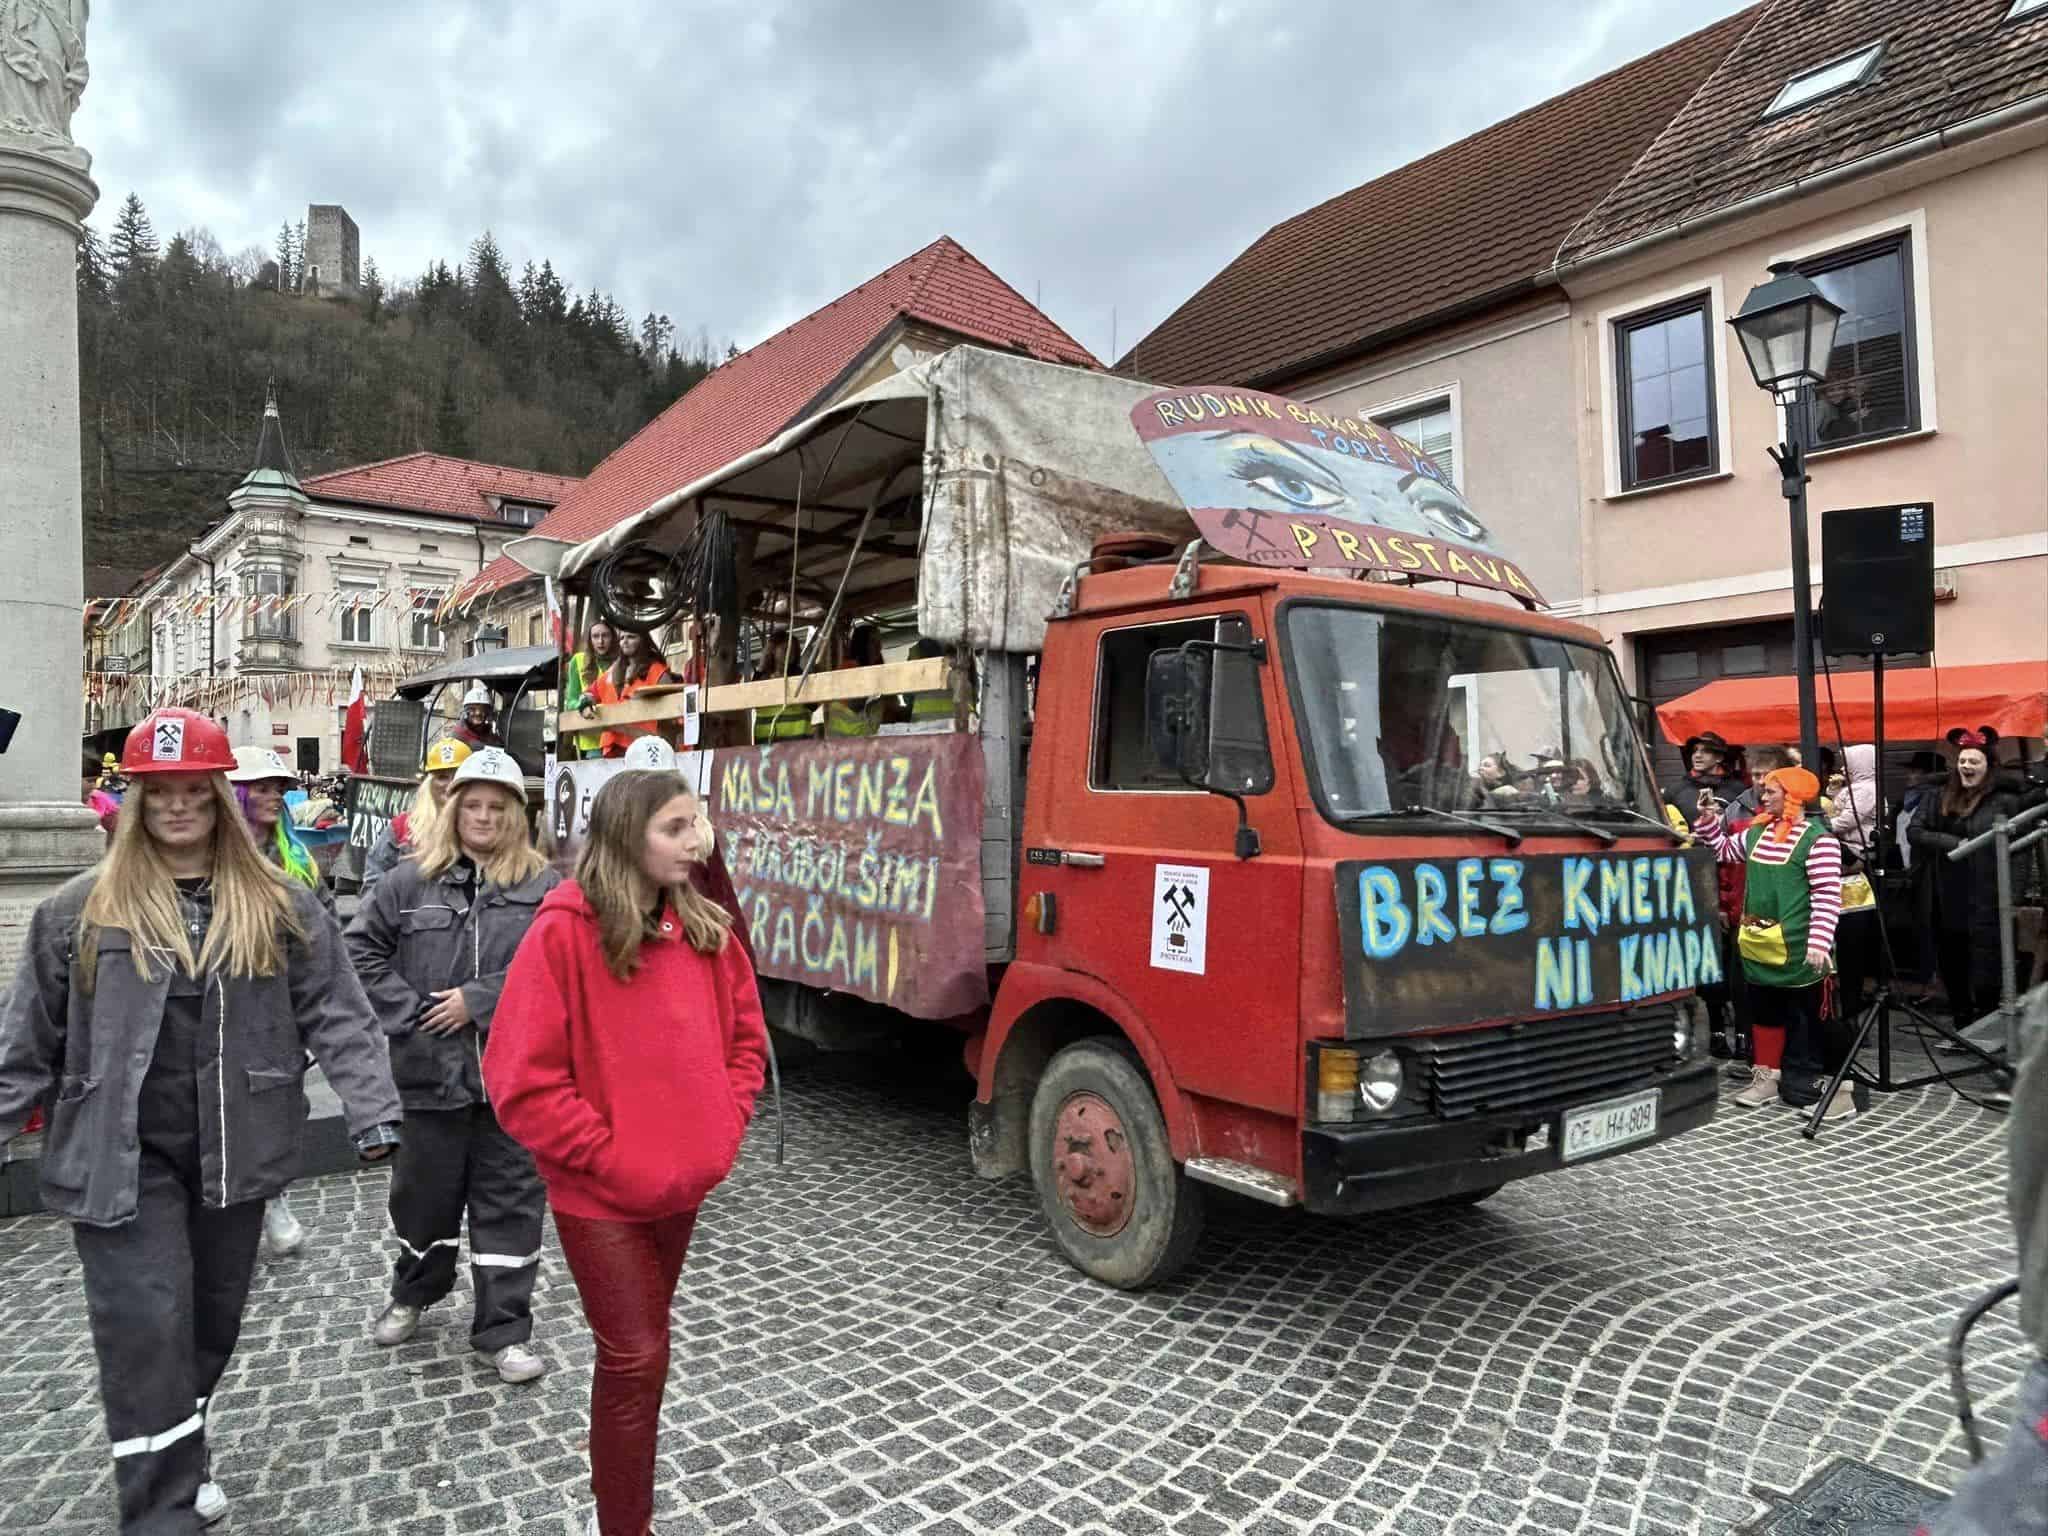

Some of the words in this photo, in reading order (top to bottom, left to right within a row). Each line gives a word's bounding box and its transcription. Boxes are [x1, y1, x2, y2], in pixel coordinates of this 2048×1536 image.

[1154, 393, 1281, 427] RUDNIK
[1286, 403, 1382, 441] BAKRA
[1310, 428, 1397, 464] TOPLE
[1289, 523, 1538, 597] PRISTAVA
[719, 745, 797, 824] NAŠA
[1562, 857, 1697, 936] KMETA
[1534, 935, 1594, 1010] NI
[1619, 923, 1723, 1001] KNAPA
